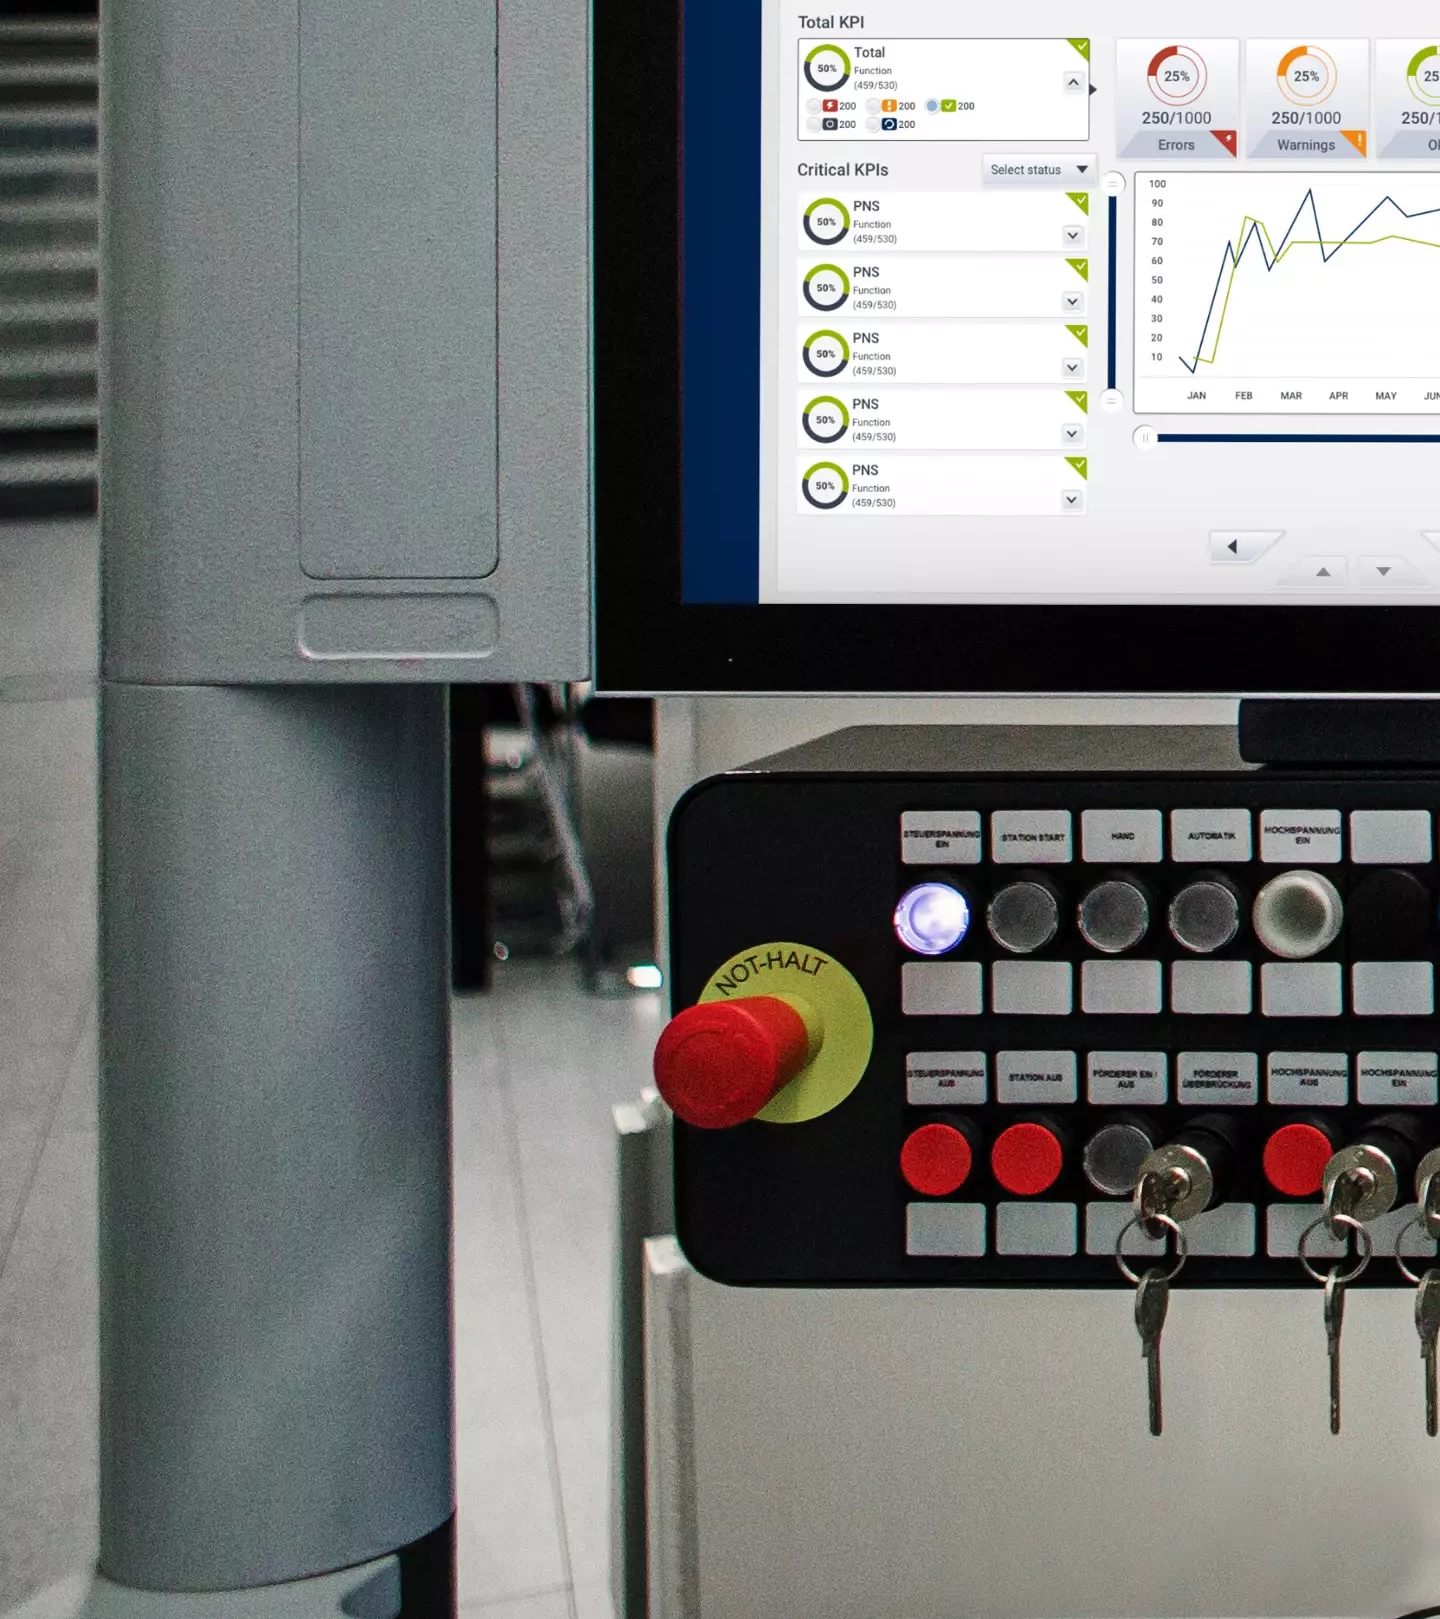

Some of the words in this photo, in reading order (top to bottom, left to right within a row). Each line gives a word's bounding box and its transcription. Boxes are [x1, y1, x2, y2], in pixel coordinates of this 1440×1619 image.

[798, 15, 834, 29] Total
[839, 15, 864, 29] KPI
[854, 46, 885, 58] Total
[817, 64, 837, 73] 50%
[854, 66, 893, 75] Function
[1164, 70, 1190, 82] 25%
[1294, 70, 1320, 82] 25%
[854, 80, 898, 92] (459/530)
[839, 101, 857, 111] 200
[1142, 111, 1212, 125] 250/1000
[1271, 111, 1342, 125] 250/1000
[1158, 138, 1196, 151] Errors
[1277, 139, 1336, 154] Warnings
[797, 162, 850, 177] Critical
[854, 162, 889, 177] KPIs
[991, 163, 1025, 175] Select
[1027, 165, 1062, 175] status
[1149, 179, 1167, 189] 100
[853, 200, 880, 212] PNS
[1151, 198, 1164, 208] 90
[817, 217, 837, 226] 50%
[853, 219, 892, 229] Function
[1151, 217, 1164, 227] 80
[853, 234, 898, 245] (459/530)
[1151, 236, 1164, 246] 70
[1151, 256, 1164, 265] 60
[853, 266, 880, 278] PNS
[1151, 275, 1164, 285] 50
[816, 283, 836, 293] 50%
[853, 286, 891, 295] Function
[1151, 294, 1163, 304] 40
[853, 300, 897, 311] (459/530)
[1151, 313, 1163, 323] 30
[853, 332, 880, 344] PNS
[1151, 333, 1163, 343] 20
[1151, 352, 1163, 362] 10
[1187, 391, 1207, 400] JAN
[1235, 391, 1253, 400] FEB
[1280, 391, 1303, 400] MAR
[1328, 391, 1349, 400] APR
[1375, 391, 1397, 400] MAY
[852, 398, 879, 410] PNS
[852, 464, 879, 476] PNS
[815, 481, 835, 491] 50%
[852, 483, 891, 493] Function
[852, 498, 896, 509] (459/530)
[904, 830, 980, 839] STEUERSPANNUNG
[1111, 832, 1135, 840] HAND
[1188, 832, 1236, 840] AUTOMATIK
[1264, 827, 1340, 835] HOCHSPANNUNG
[1002, 833, 1037, 842] STATION
[1039, 833, 1065, 841] START
[1296, 837, 1310, 845] EIN
[936, 840, 949, 848] EIN
[715, 950, 828, 996] NOT-HALT
[1046, 1073, 1063, 1081] AUS
[1271, 1069, 1347, 1077] HOCHSPANNUNG
[1361, 1069, 1437, 1077] HOCHSPANNUNG
[1300, 1079, 1318, 1087] AUS
